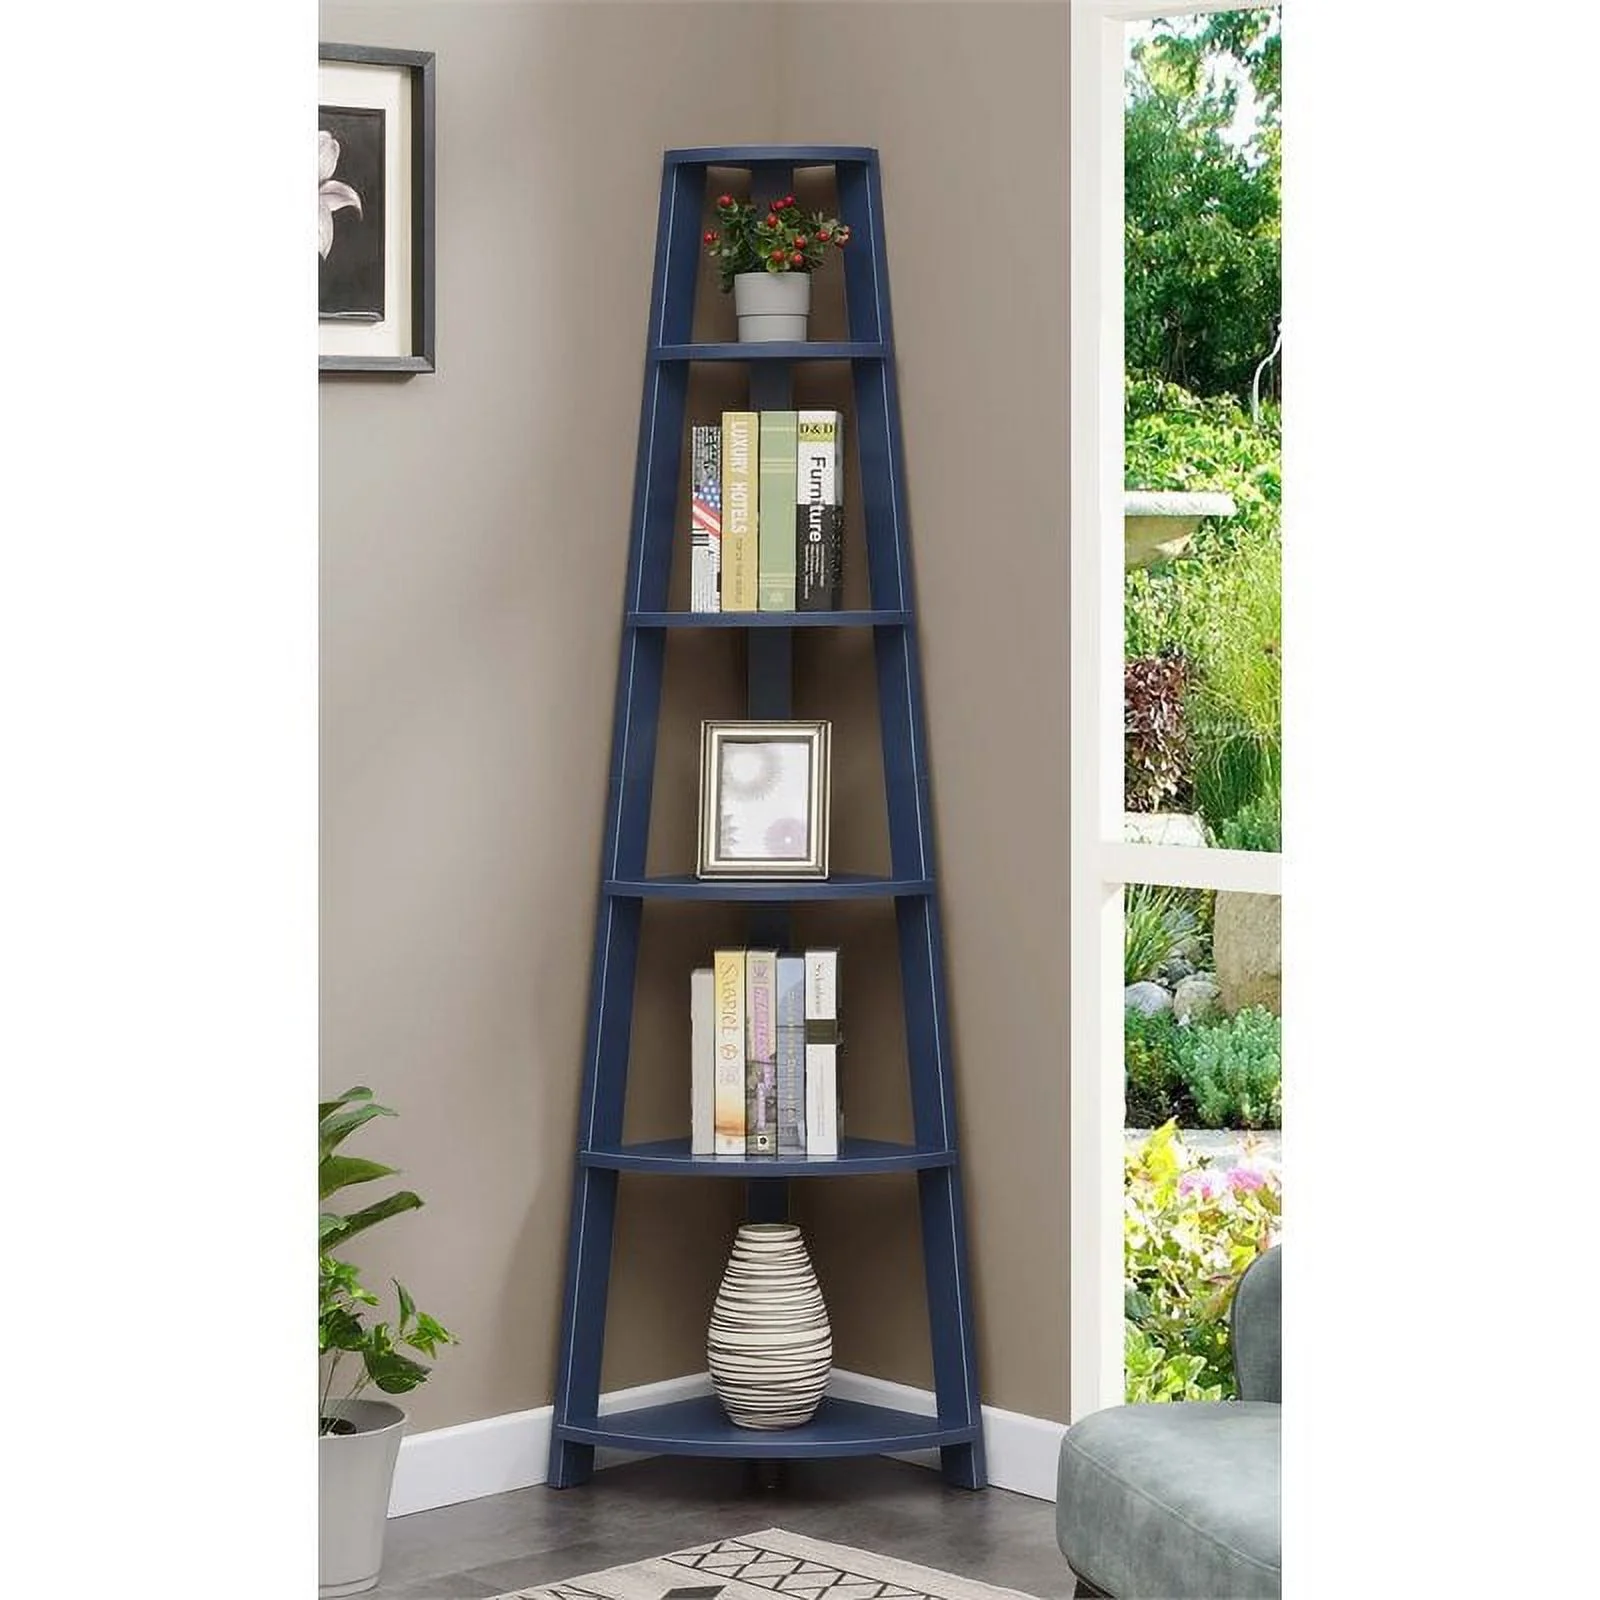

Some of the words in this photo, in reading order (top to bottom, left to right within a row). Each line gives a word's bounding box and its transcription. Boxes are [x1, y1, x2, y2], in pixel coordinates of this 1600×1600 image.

[730, 420, 749, 474] LUXURY
[730, 483, 749, 534] HOTELS
[809, 456, 827, 543] Furniture
